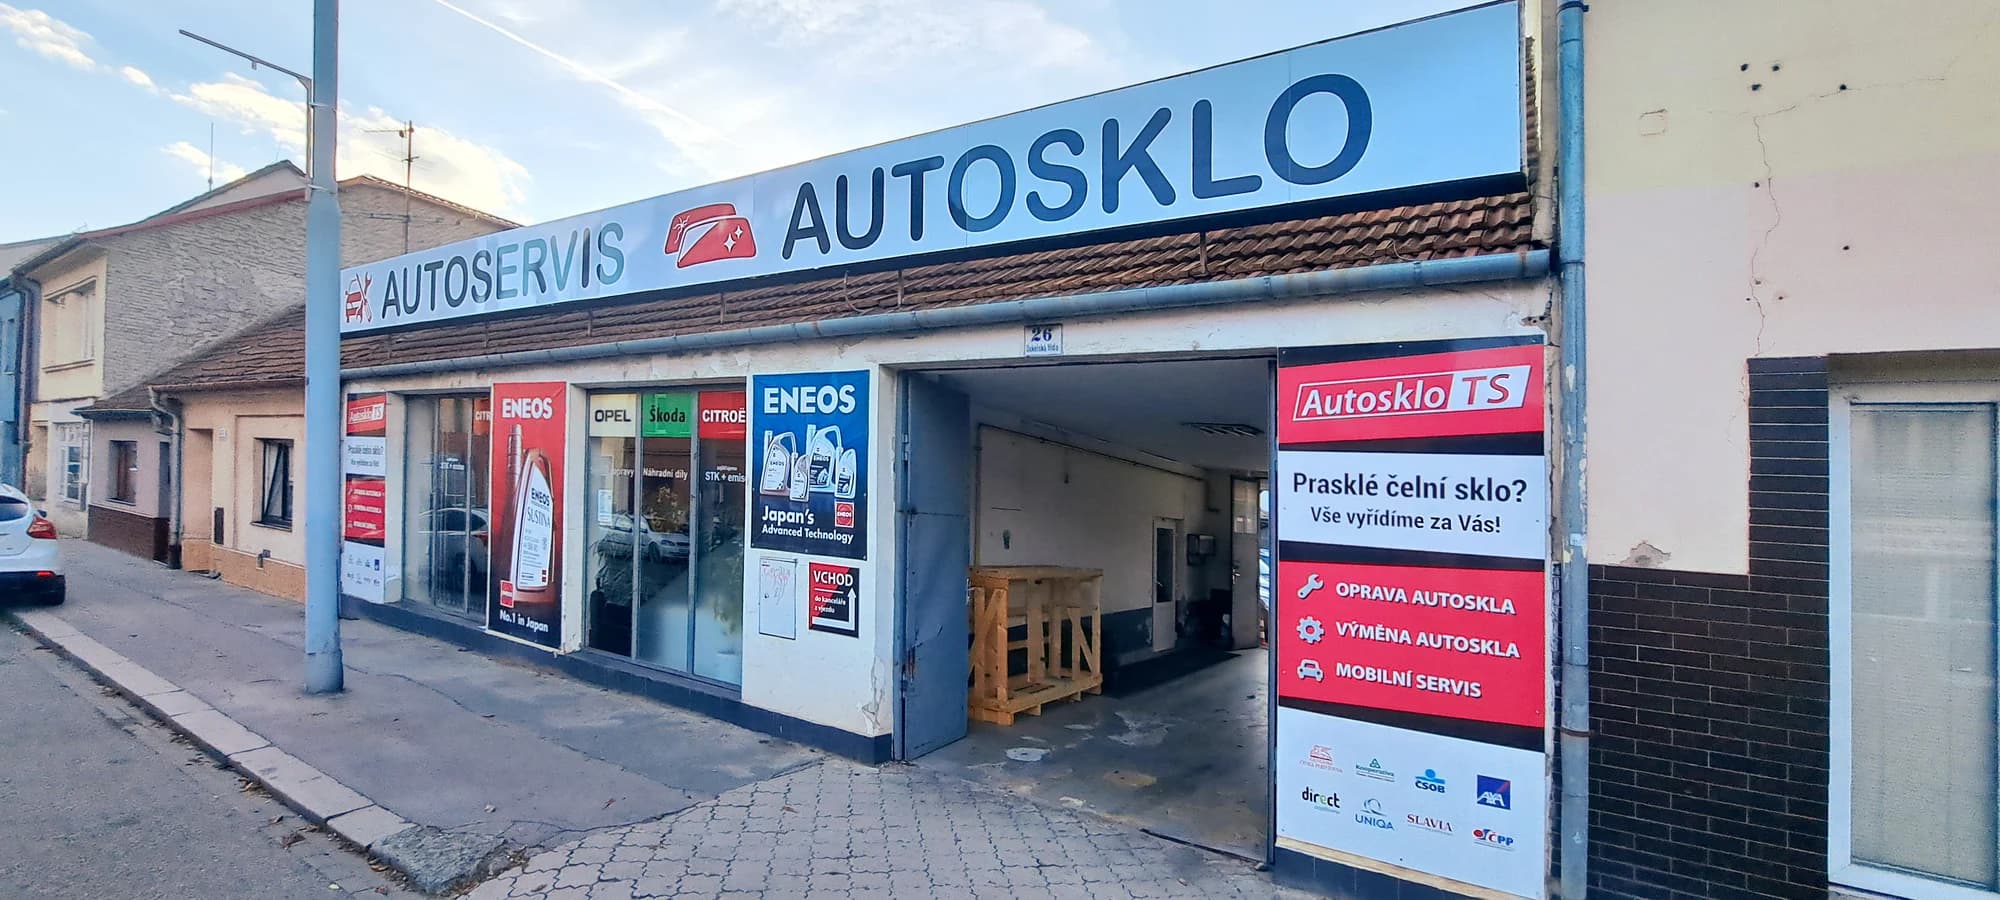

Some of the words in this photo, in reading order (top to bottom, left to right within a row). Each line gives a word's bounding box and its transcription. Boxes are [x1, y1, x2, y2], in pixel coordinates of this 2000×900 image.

[782, 73, 1373, 260] AUTOSKLO
[381, 222, 625, 319] AUTOSERVIS
[1031, 327, 1052, 341] 26
[764, 385, 856, 414] ENEOS
[1301, 380, 1446, 417] Autosklo
[1462, 374, 1511, 405] TS
[502, 397, 552, 419] ENEOS
[594, 409, 631, 422] OPEL
[650, 404, 685, 423] Škoda
[643, 467, 674, 477] Náhradní
[674, 469, 688, 480] díly
[705, 471, 720, 481] STK
[531, 488, 550, 506] ENEOS
[1293, 472, 1378, 496] Prasklé
[1386, 473, 1446, 499] čelní
[1455, 477, 1527, 502] sklo?
[1311, 506, 1341, 523] Vše
[1346, 509, 1424, 529] vyřídíme
[1430, 516, 1452, 530] za
[1458, 514, 1501, 533] Vás!
[762, 523, 803, 537] Advanced
[804, 528, 853, 544] Technology
[813, 570, 854, 586] VCHOD
[1335, 582, 1408, 604] OPRAVA
[1412, 590, 1516, 615] AUTOSKLA
[500, 609, 516, 623] No.1
[518, 613, 525, 626] in
[526, 617, 549, 632] Japan
[1335, 621, 1412, 645] VÝMĚNA
[1416, 633, 1520, 659] AUTOSKLA
[1335, 661, 1413, 688] MOBILNÍ
[1416, 674, 1482, 699] SERVIS
[1301, 786, 1341, 809] direct
[1477, 791, 1505, 807] AXA
[1355, 813, 1395, 831] UNIQA
[1407, 813, 1453, 832] SLAVIA
